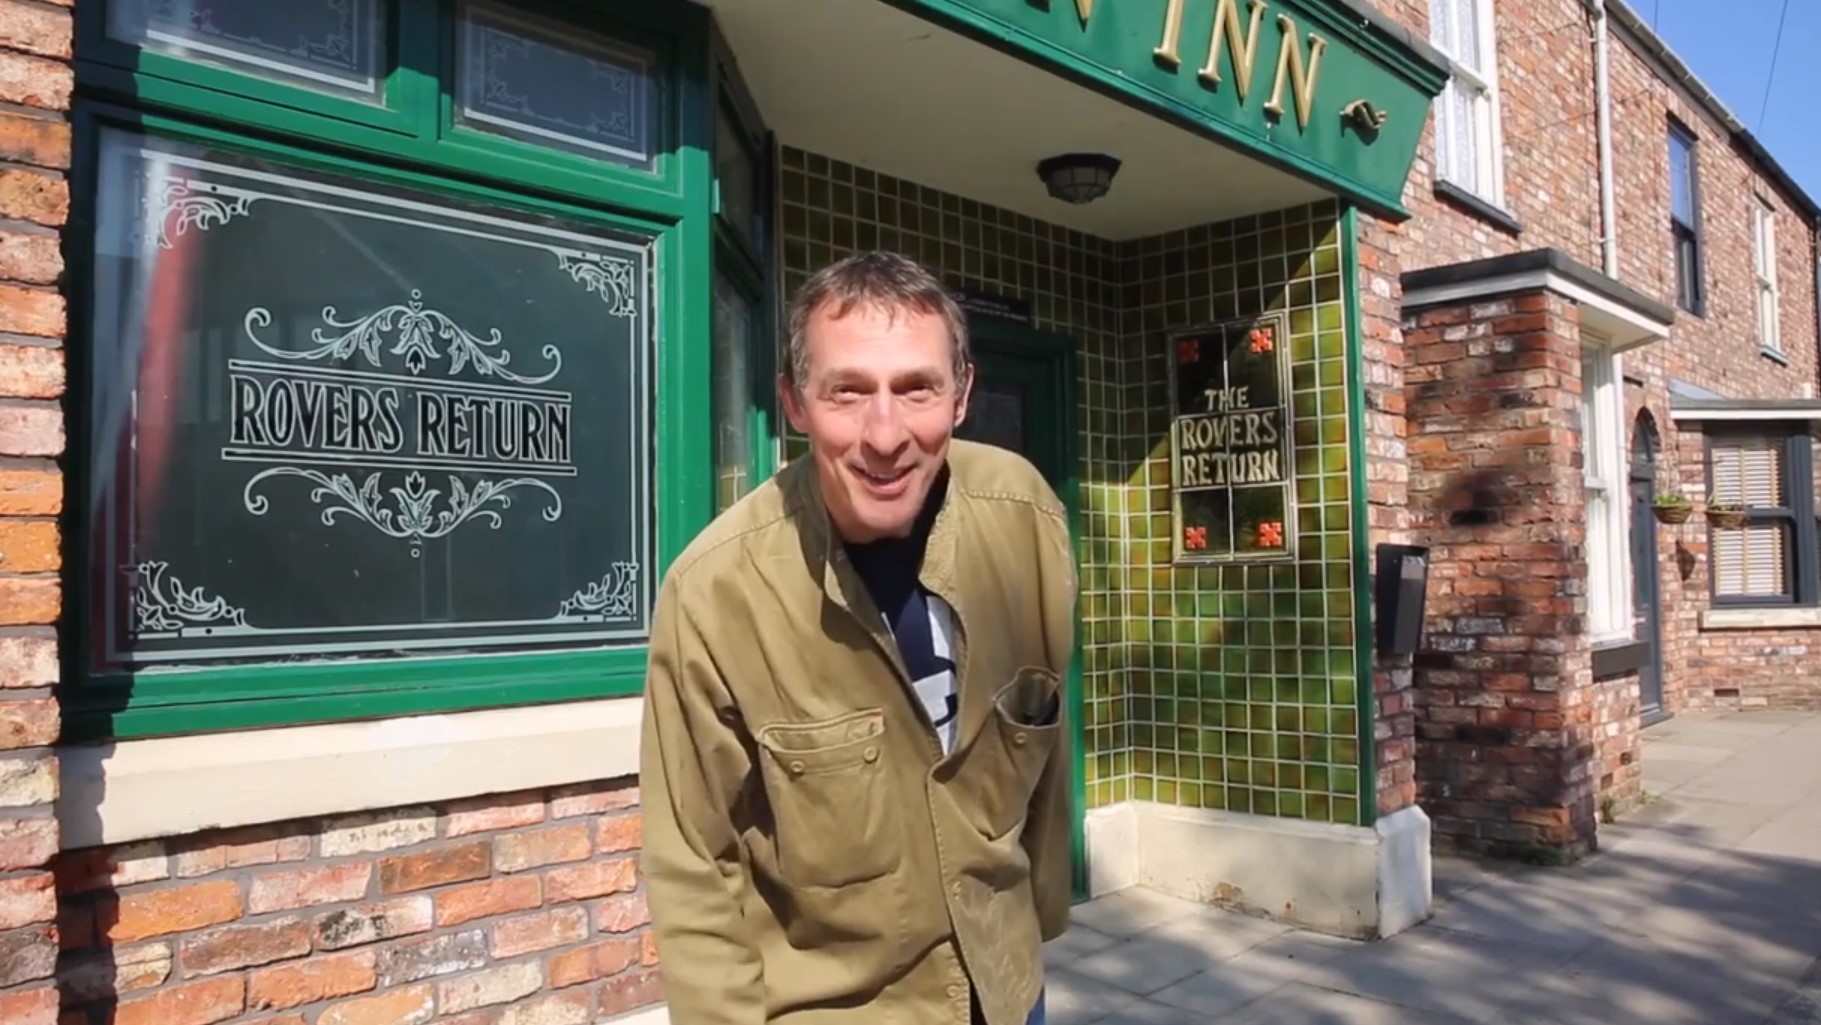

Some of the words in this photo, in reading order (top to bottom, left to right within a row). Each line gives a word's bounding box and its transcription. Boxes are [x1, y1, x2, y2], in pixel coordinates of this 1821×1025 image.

[1153, 0, 1327, 128] INN
[1204, 385, 1249, 411] THE
[230, 374, 403, 453] ROVERS
[417, 391, 571, 463] RETURN
[1180, 411, 1278, 450] ROVERS
[1182, 448, 1280, 486] RETURN
